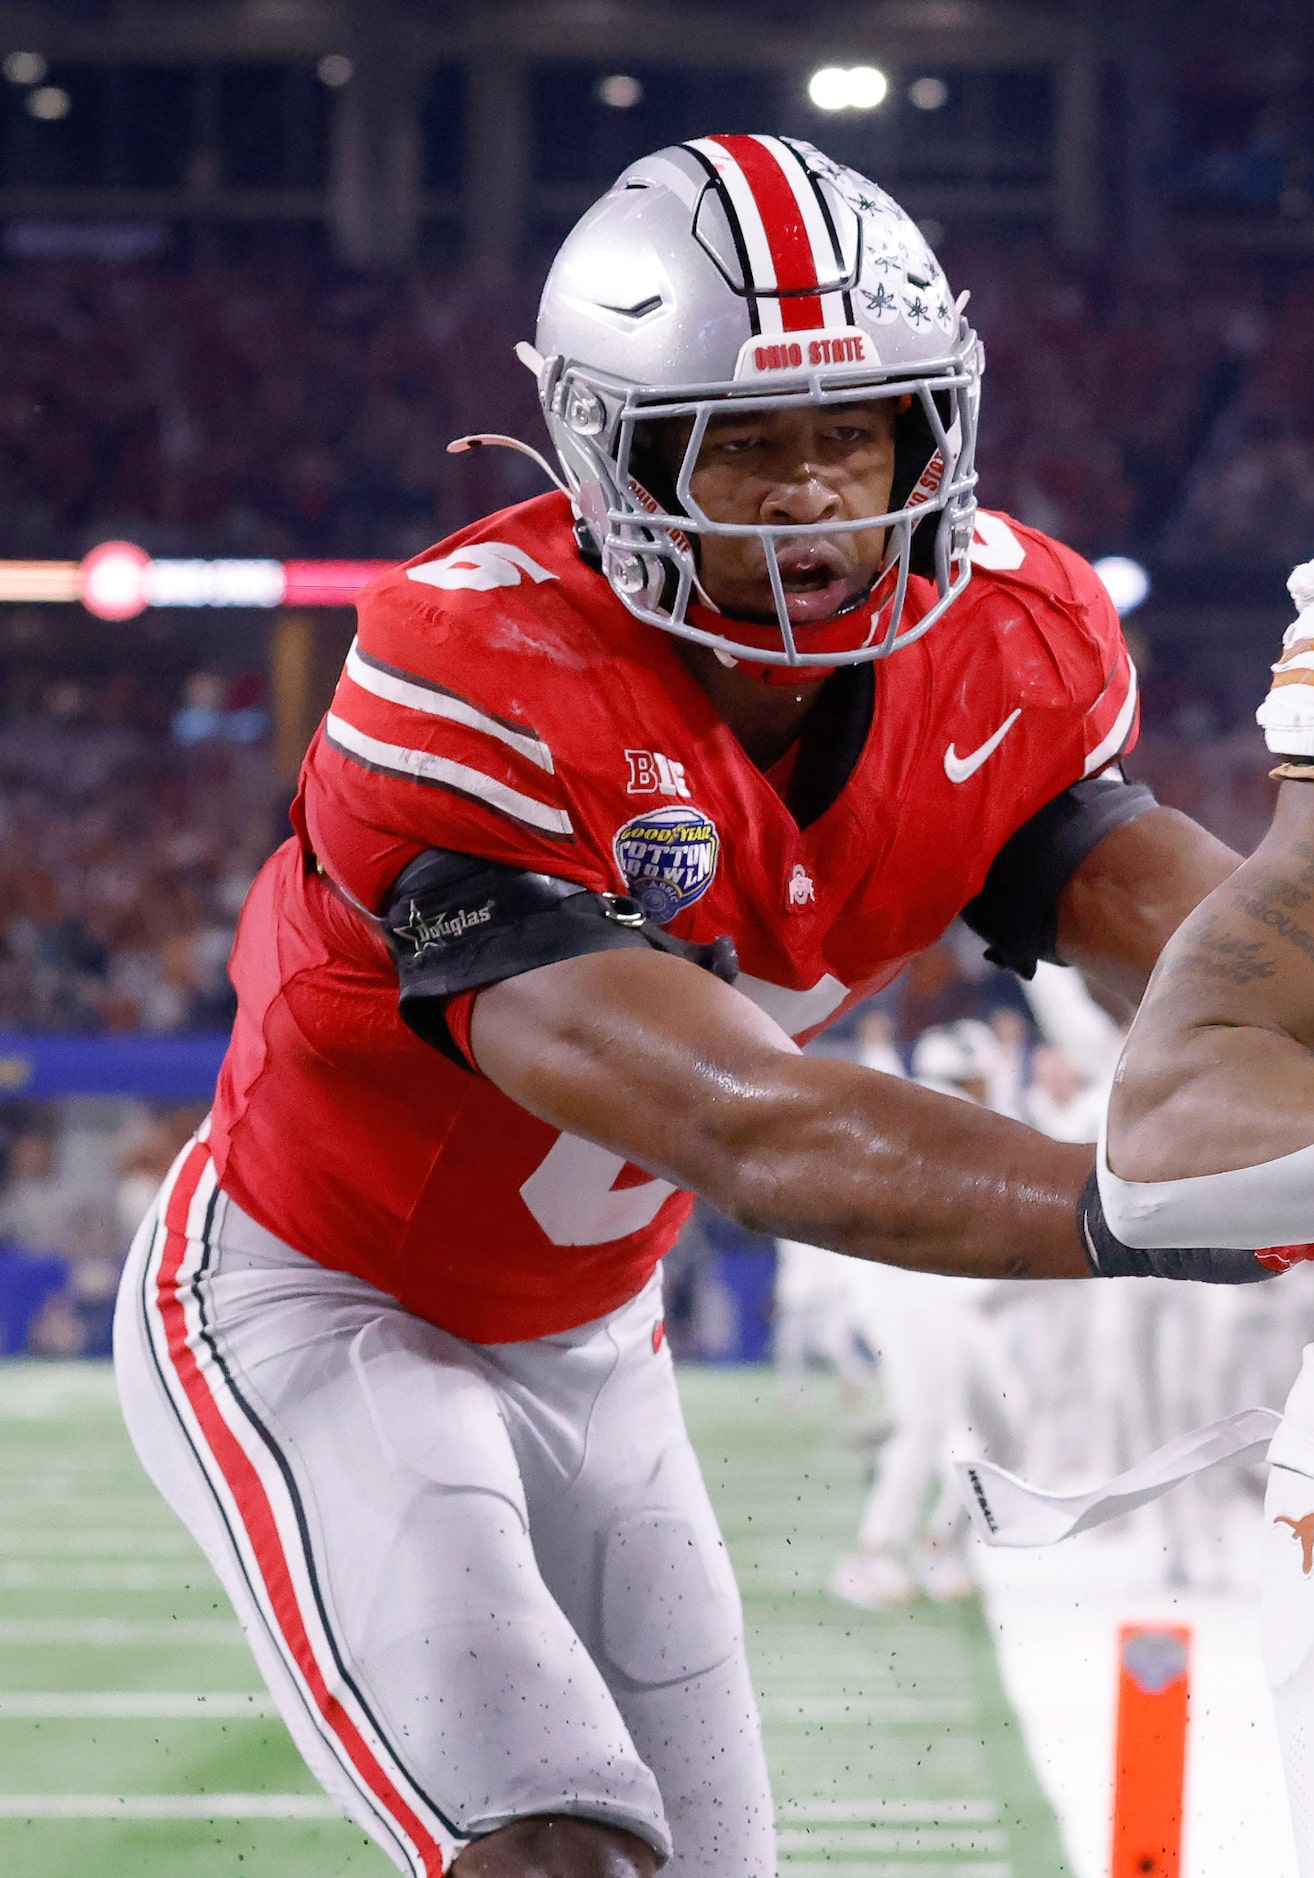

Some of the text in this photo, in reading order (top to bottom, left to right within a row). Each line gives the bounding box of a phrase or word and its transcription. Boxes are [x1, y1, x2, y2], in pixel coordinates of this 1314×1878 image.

[754, 336, 866, 371] OHIO STATE
[620, 823, 712, 845] GOODYEAR
[618, 840, 712, 883] COTTON
[624, 858, 698, 889] BOWL
[416, 906, 492, 943] Douglas
